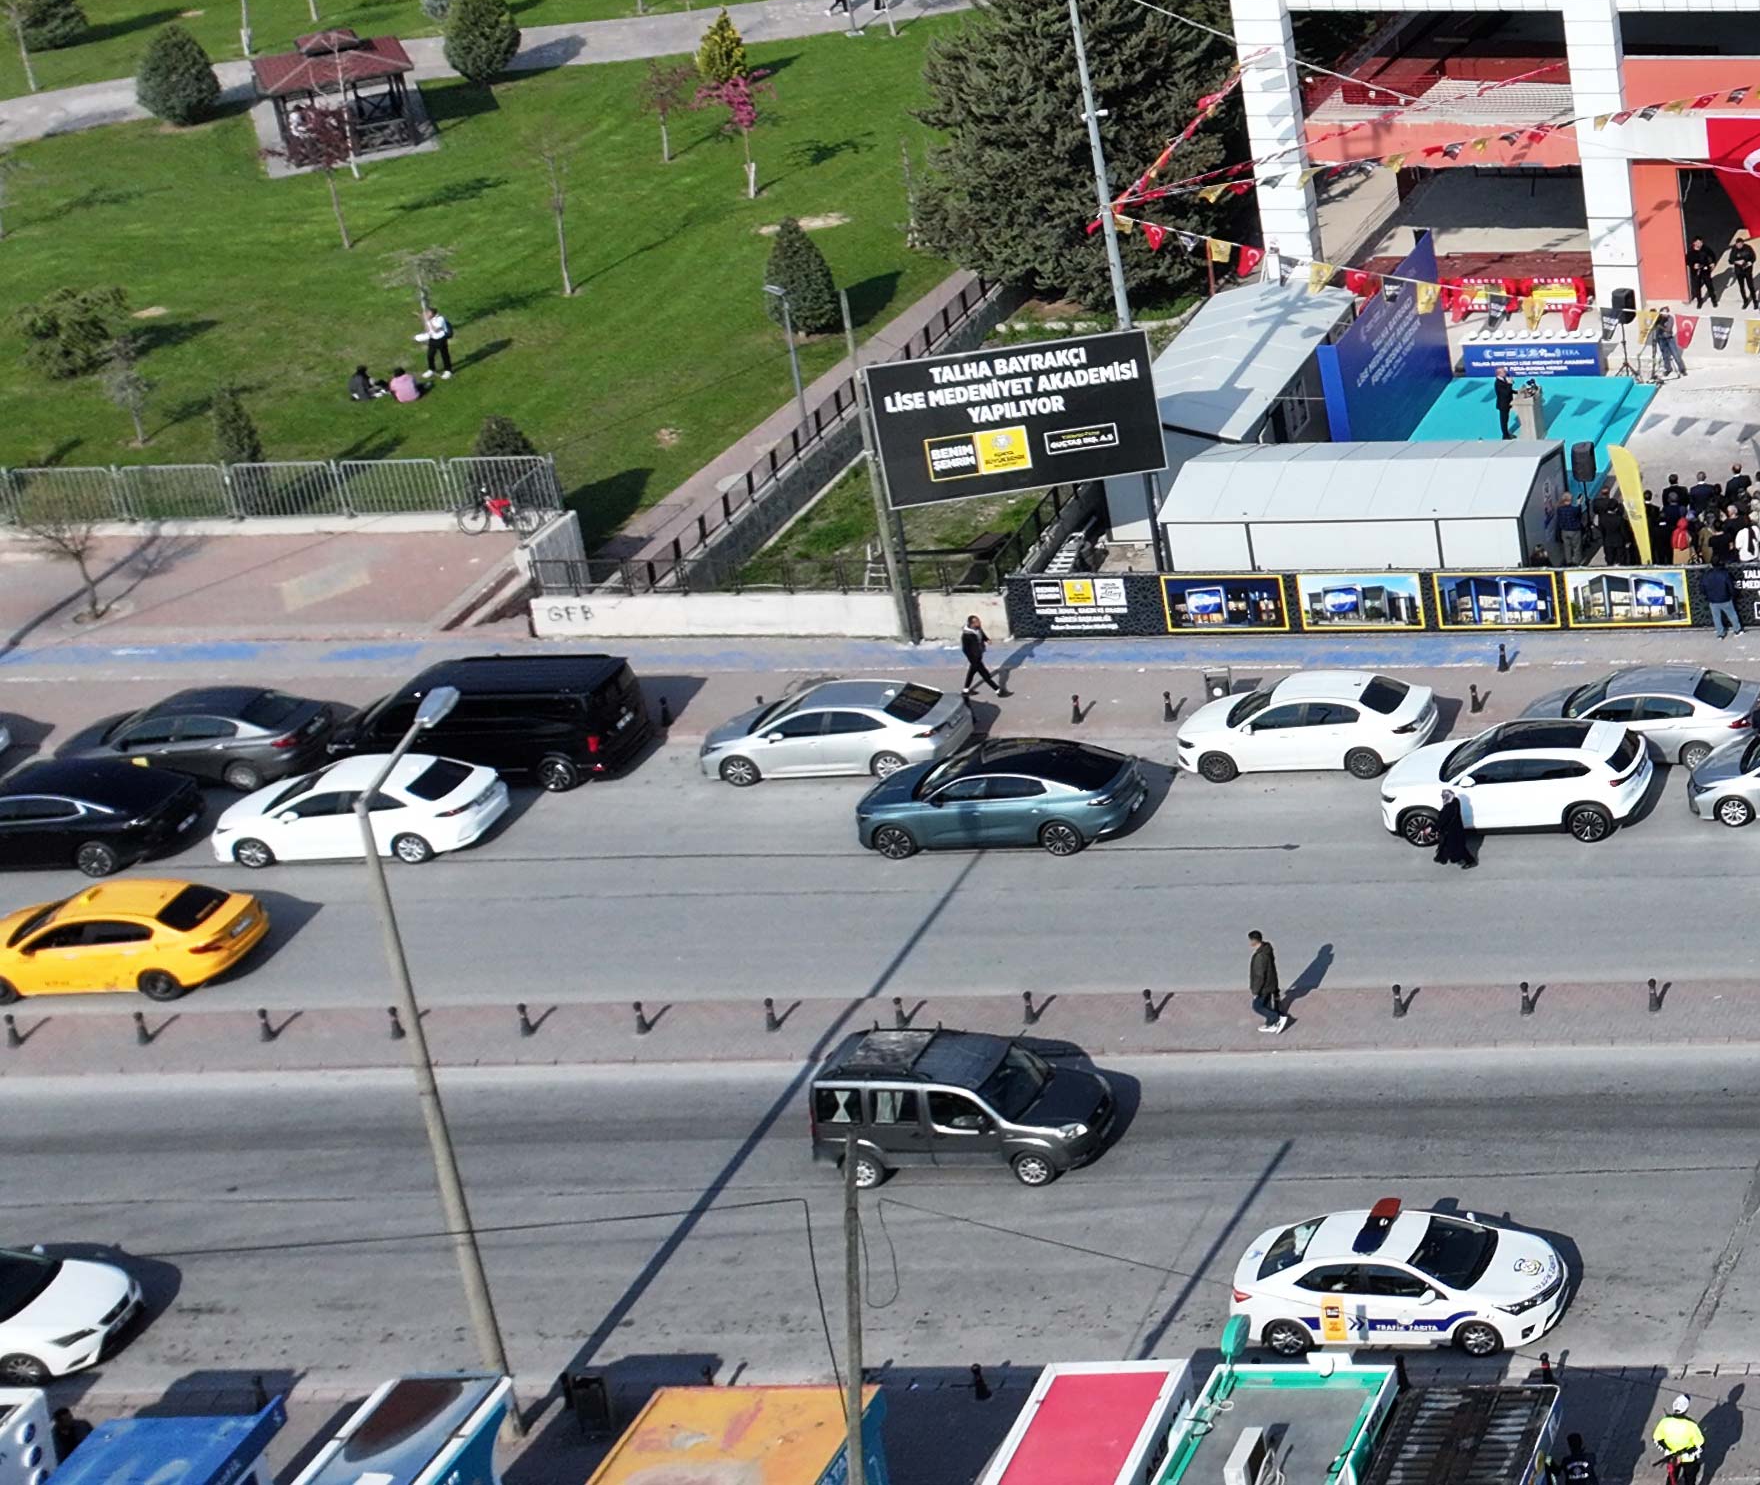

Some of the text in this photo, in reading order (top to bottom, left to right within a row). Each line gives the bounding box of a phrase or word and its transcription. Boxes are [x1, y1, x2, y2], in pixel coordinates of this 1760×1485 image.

[929, 347, 1087, 384] TALHA BAYRAKÇI
[885, 359, 1139, 413] LİSE MEDENİYET AKADEMİSİ
[967, 395, 1066, 423] YAPILIYOR
[930, 443, 974, 460] BENİM
